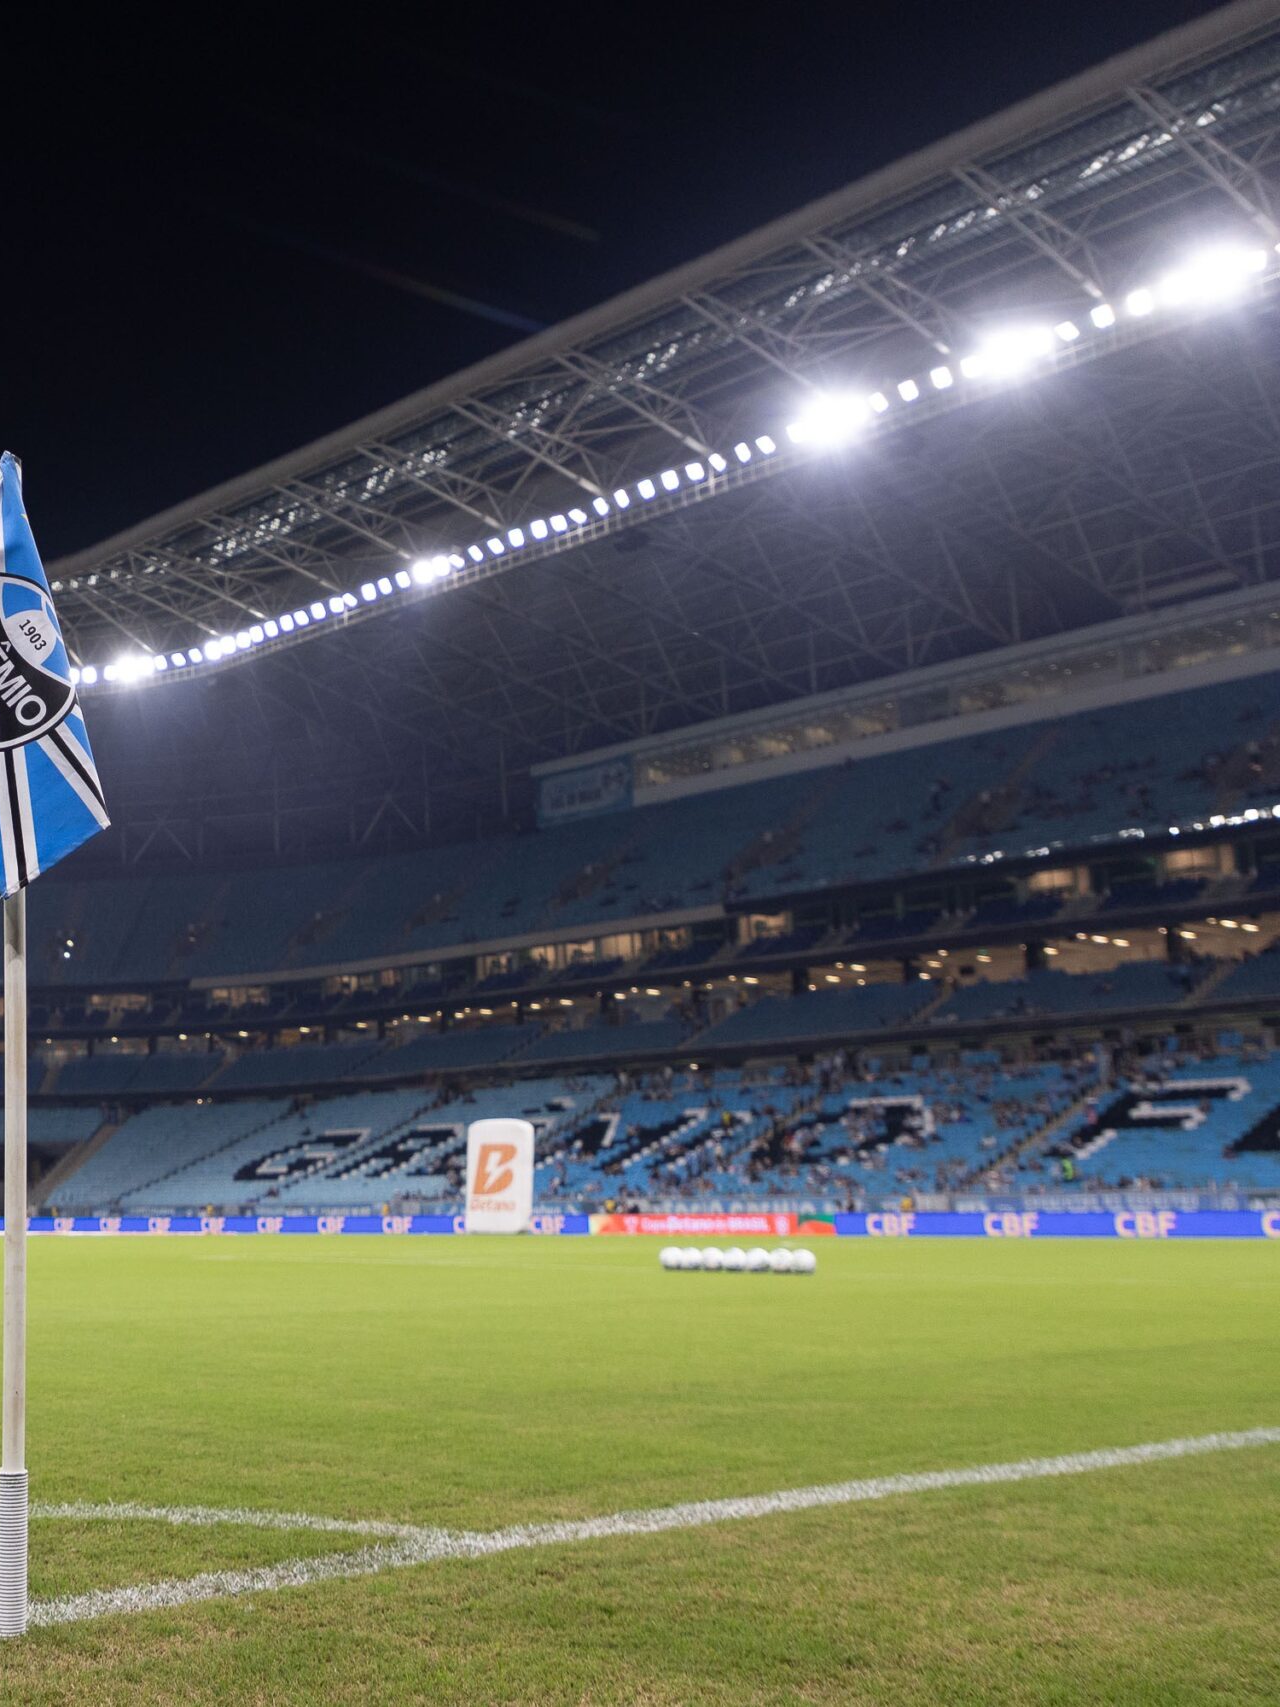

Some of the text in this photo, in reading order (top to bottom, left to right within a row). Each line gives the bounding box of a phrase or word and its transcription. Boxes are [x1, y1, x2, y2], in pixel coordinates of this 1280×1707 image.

[19, 619, 47, 651] 1903
[865, 1213, 916, 1235] CBF
[983, 1212, 1039, 1236] CBF
[1114, 1211, 1176, 1237] CBF
